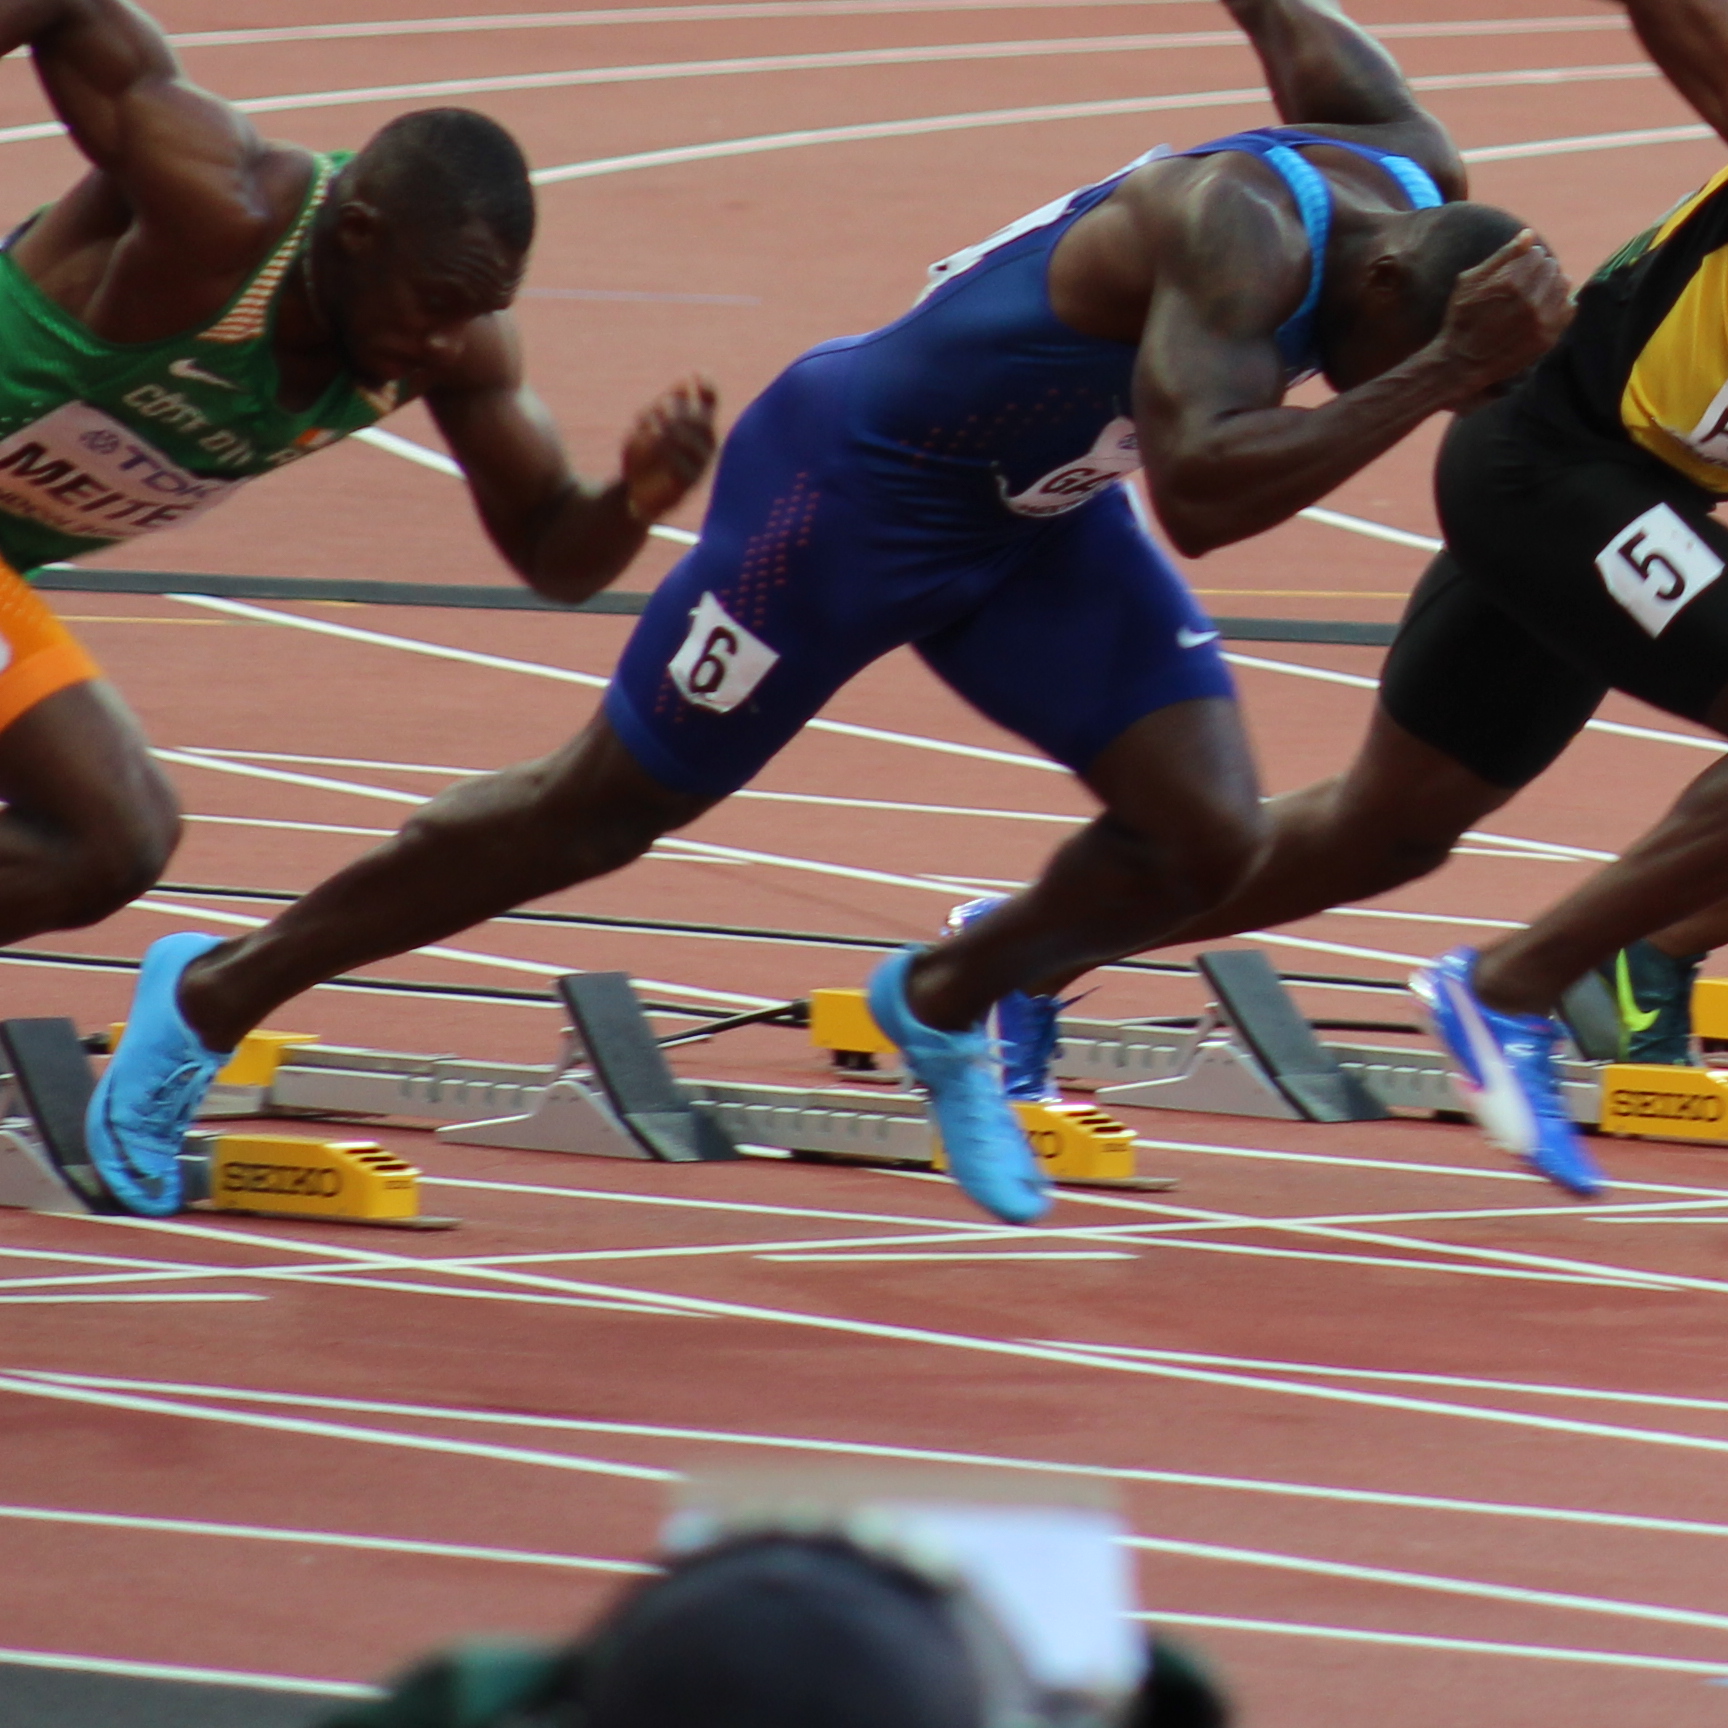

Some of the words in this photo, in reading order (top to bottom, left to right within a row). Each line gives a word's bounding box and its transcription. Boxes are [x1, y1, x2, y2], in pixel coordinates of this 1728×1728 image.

[1617, 530, 1686, 600] 5
[688, 624, 739, 694] 6
[1610, 1088, 1727, 1123] SEIKO
[223, 1161, 344, 1199] SEIKO
